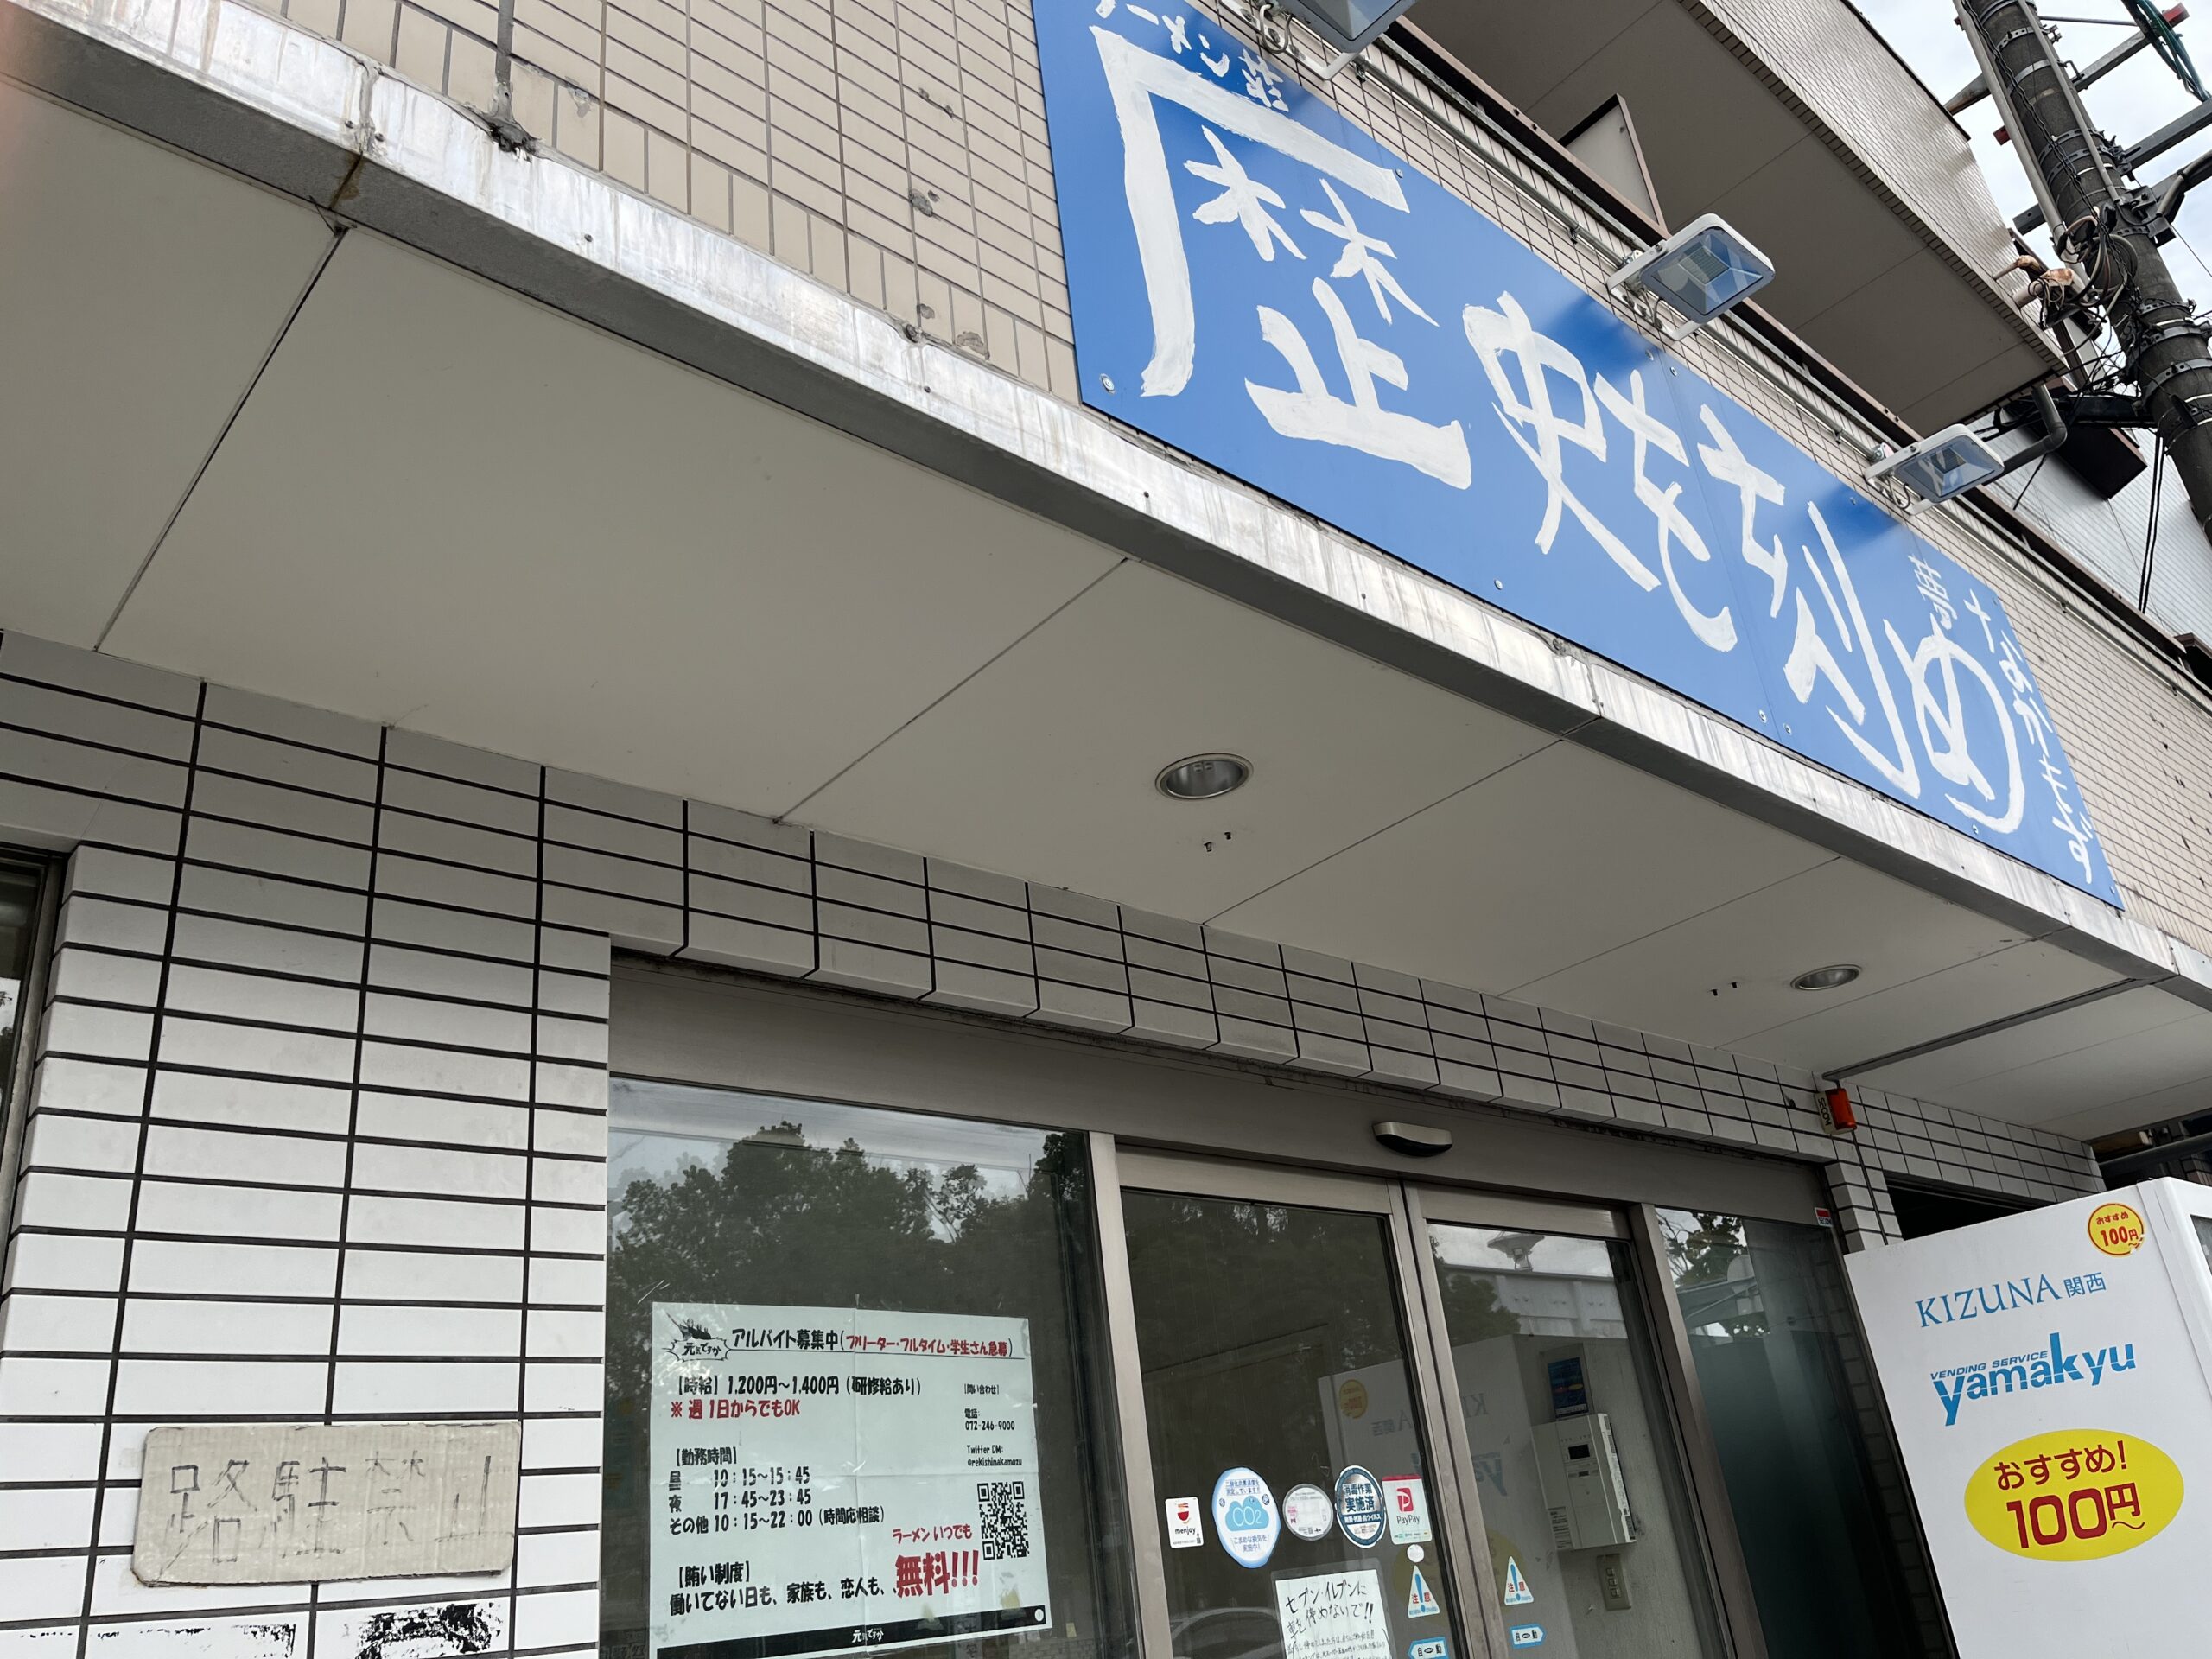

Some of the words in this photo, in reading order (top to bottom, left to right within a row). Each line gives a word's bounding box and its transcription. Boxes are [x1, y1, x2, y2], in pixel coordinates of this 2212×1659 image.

[1089, 26, 2025, 834] 歴史を刻め
[1817, 1097, 1832, 1126] SECOM
[2096, 1211, 2129, 1225] おすすめ
[1915, 1273, 2063, 1328] KIZUNA
[2063, 1272, 2107, 1298] 関西
[1929, 1362, 1987, 1381] VENDING
[1992, 1350, 2049, 1369] SERVICE
[1933, 1332, 2137, 1426] yamakyu
[964, 1421, 1015, 1431] 072-246-9000
[967, 1445, 990, 1455] Twitter
[967, 1457, 1023, 1467] @rekishinakamozu
[1993, 1440, 2127, 1491] おすすめ!
[668, 1494, 682, 1513] 夜
[1344, 1495, 1375, 1512] 実施済
[1233, 1506, 1262, 1527] CO2
[1396, 1515, 1420, 1525] PayPay
[1174, 1526, 1196, 1535] menjoy
